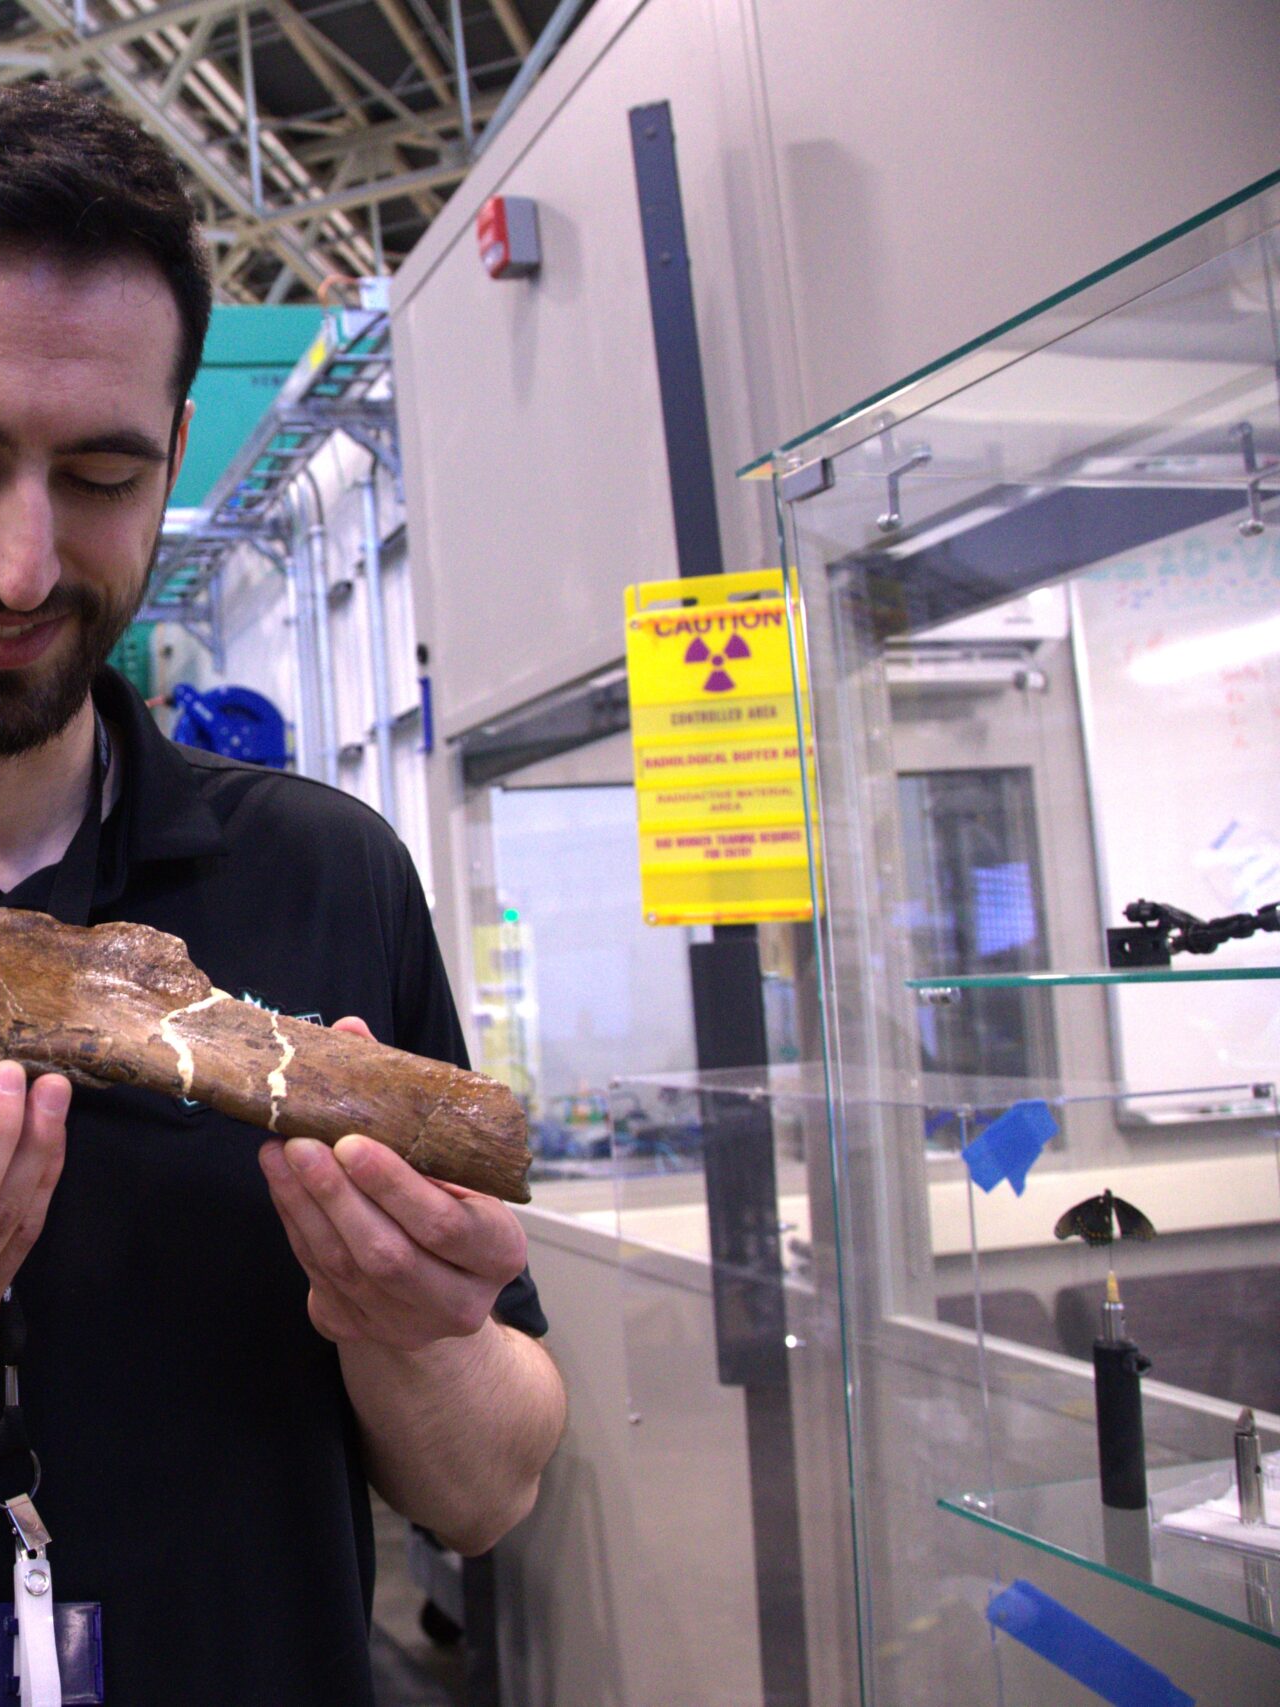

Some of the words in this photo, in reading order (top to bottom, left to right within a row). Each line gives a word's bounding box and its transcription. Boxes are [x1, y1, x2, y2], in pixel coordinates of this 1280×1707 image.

[654, 610, 782, 637] CAUTION
[671, 708, 742, 726] CONTROLLED
[748, 706, 776, 720] AREA
[783, 747, 813, 759] ARA
[710, 803, 741, 812] AREA
